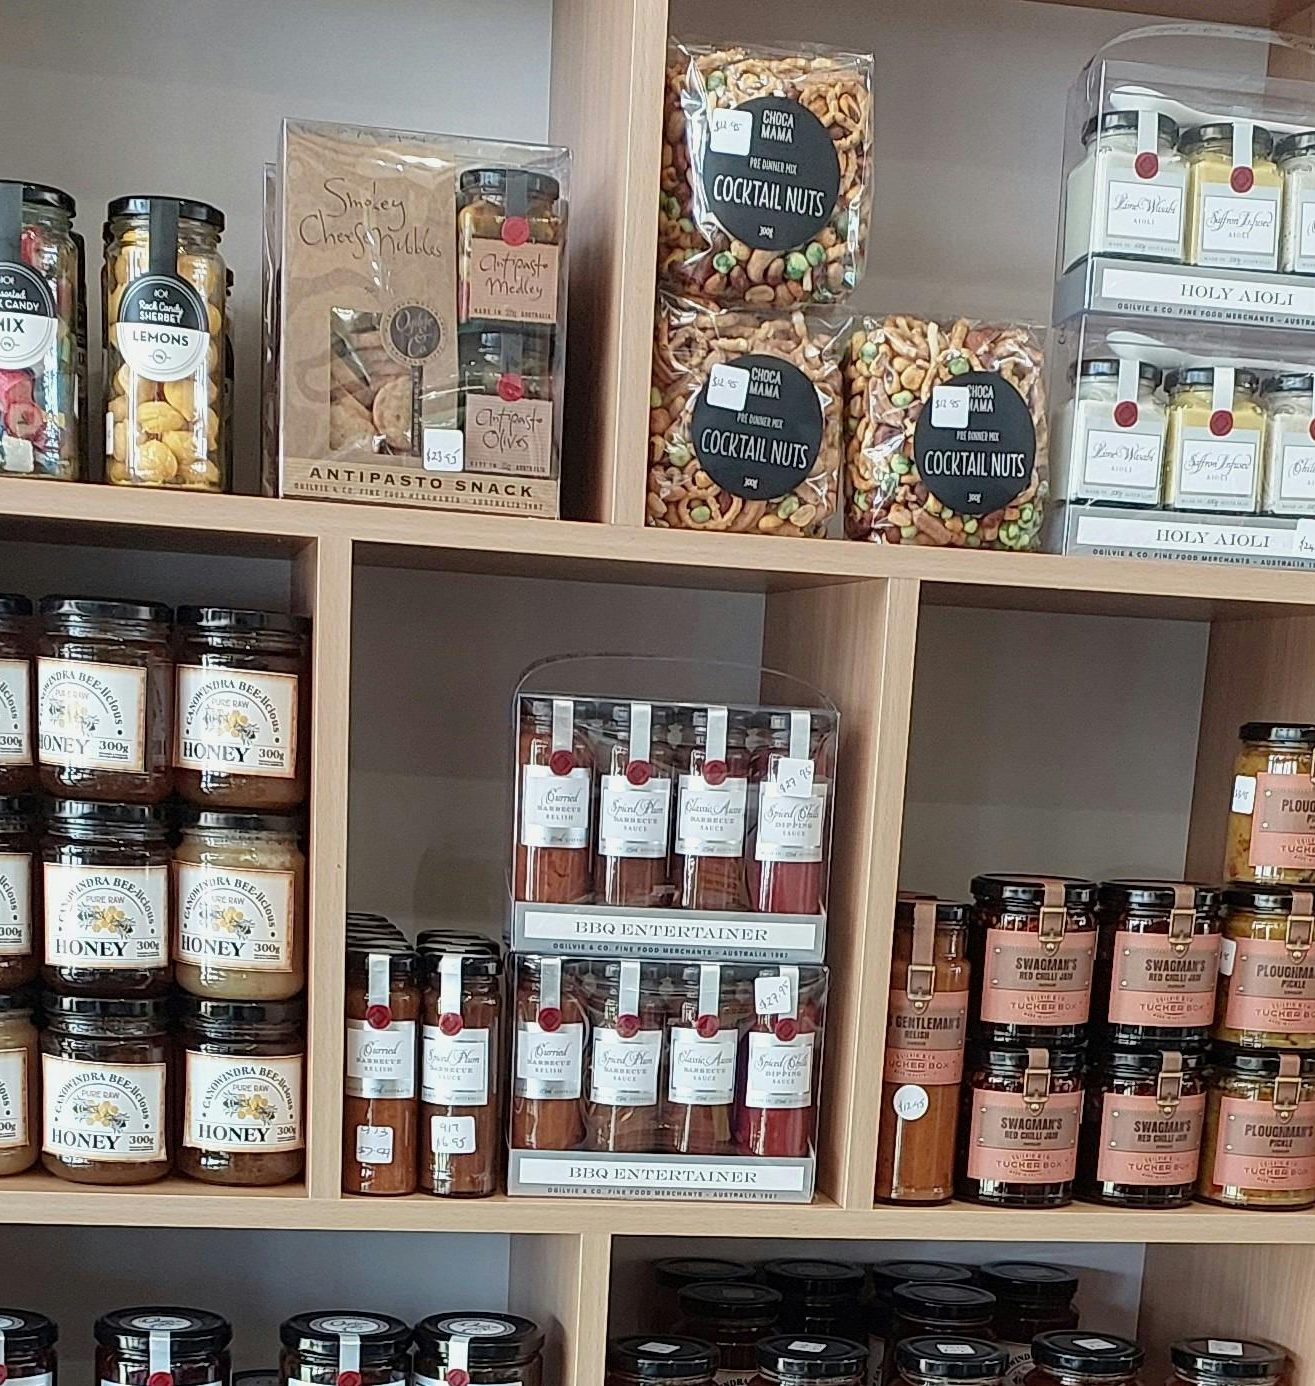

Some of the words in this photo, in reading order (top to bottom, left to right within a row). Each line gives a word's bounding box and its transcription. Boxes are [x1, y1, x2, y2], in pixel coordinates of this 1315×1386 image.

[762, 109, 794, 128] CHOCA
[761, 125, 793, 144] MAMA
[714, 175, 781, 209] COCKTAIL
[786, 187, 825, 218] NUTS
[1181, 283, 1233, 300] HOLY
[1239, 290, 1293, 306] AIOLI
[6, 299, 40, 312] CANDY
[160, 304, 184, 318] Candy
[1118, 303, 1150, 311] OGILVIE
[138, 312, 182, 324] SHERBET
[132, 330, 189, 347] LEMONS
[483, 430, 528, 452] Olives
[701, 428, 767, 462] COCKTAIL
[771, 440, 809, 469] NUTS
[310, 467, 442, 489] ANTIPASTO
[455, 480, 533, 497] SNACK
[183, 741, 251, 763] HONEY
[258, 748, 284, 762] 300g
[575, 921, 616, 935] BBQ
[622, 923, 768, 941] ENTERTAINER
[55, 937, 128, 958] HONEY
[1015, 957, 1078, 972] SWAGMAN'S
[1018, 971, 1035, 981] RED
[896, 1015, 961, 1032] GENTLEMAN'S
[905, 1029, 930, 1040] RELISH
